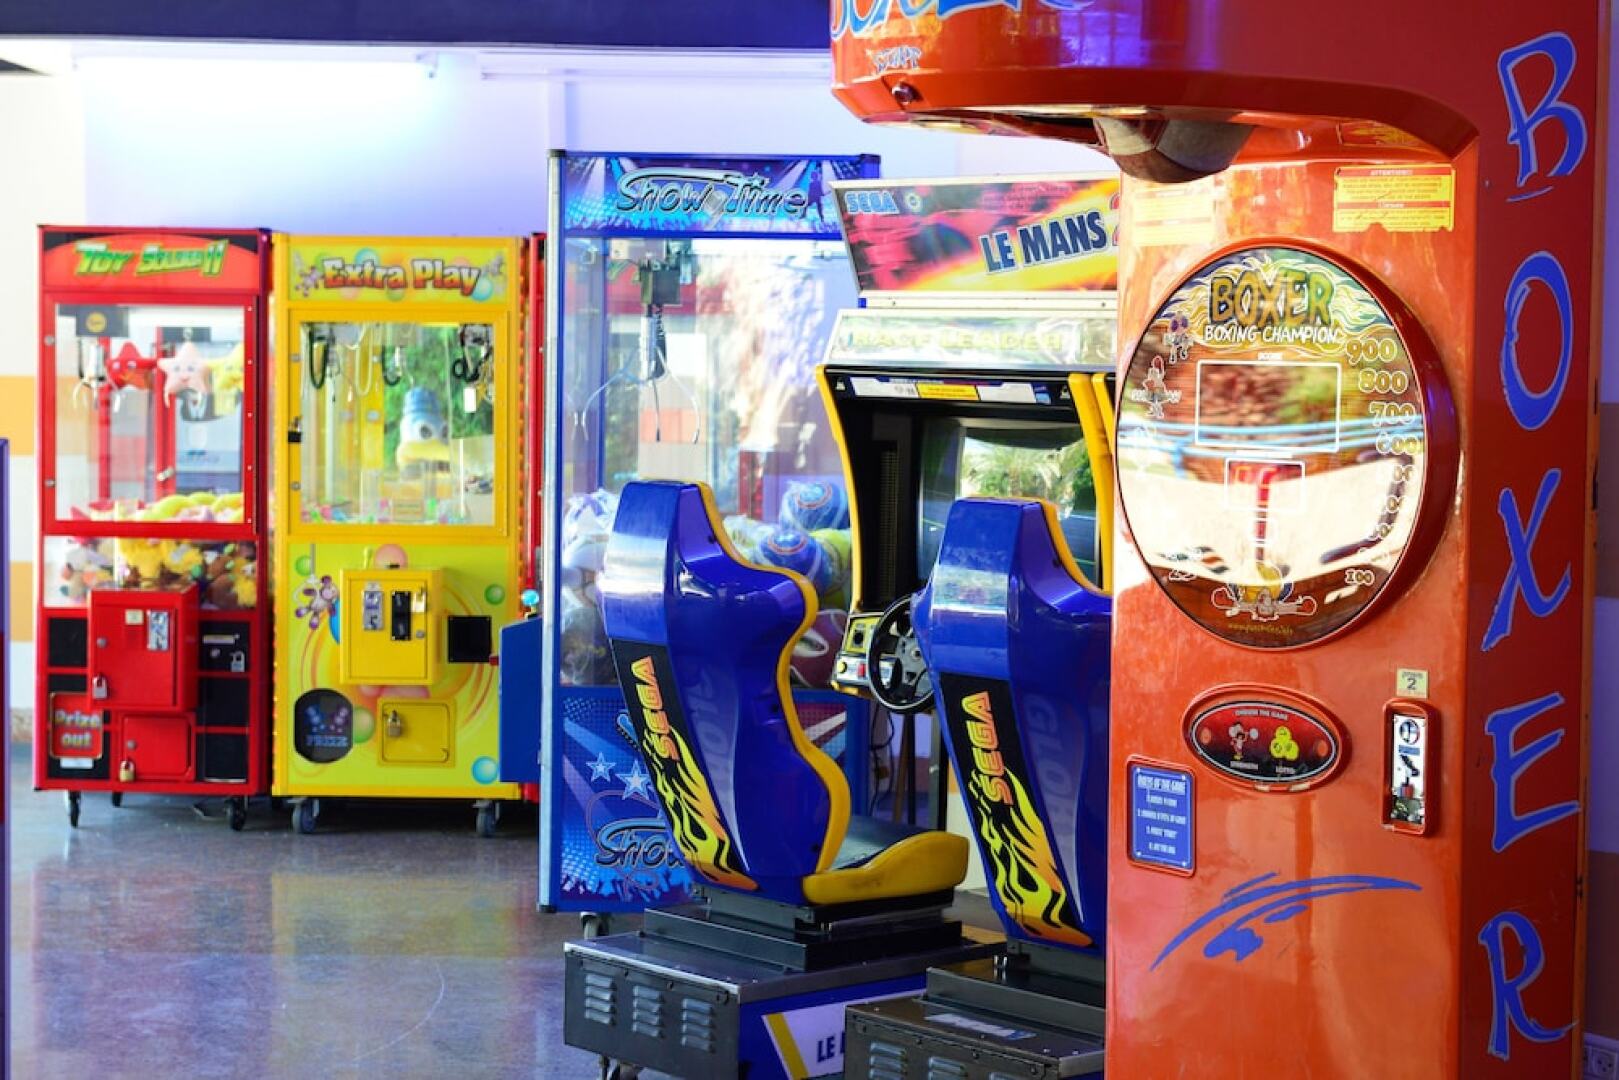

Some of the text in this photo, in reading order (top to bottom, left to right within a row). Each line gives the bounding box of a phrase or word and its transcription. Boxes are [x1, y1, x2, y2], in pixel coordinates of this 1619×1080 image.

[617, 167, 808, 218] Show Time
[845, 190, 899, 214] SEGA
[979, 232, 1017, 273] LE
[1018, 209, 1108, 267] MANS
[322, 257, 481, 297] Extra Play
[1210, 268, 1334, 327] BOXER
[1346, 338, 1398, 365] 900
[1358, 368, 1408, 394] 800
[1369, 401, 1416, 426] 700
[1478, 31, 1588, 1061] BOXER
[1406, 677, 1417, 690] 2
[55, 708, 101, 730] Prize
[631, 656, 681, 761] SEGA
[62, 732, 92, 748] out
[962, 691, 1014, 806] SEGA
[817, 1036, 835, 1063] LE
